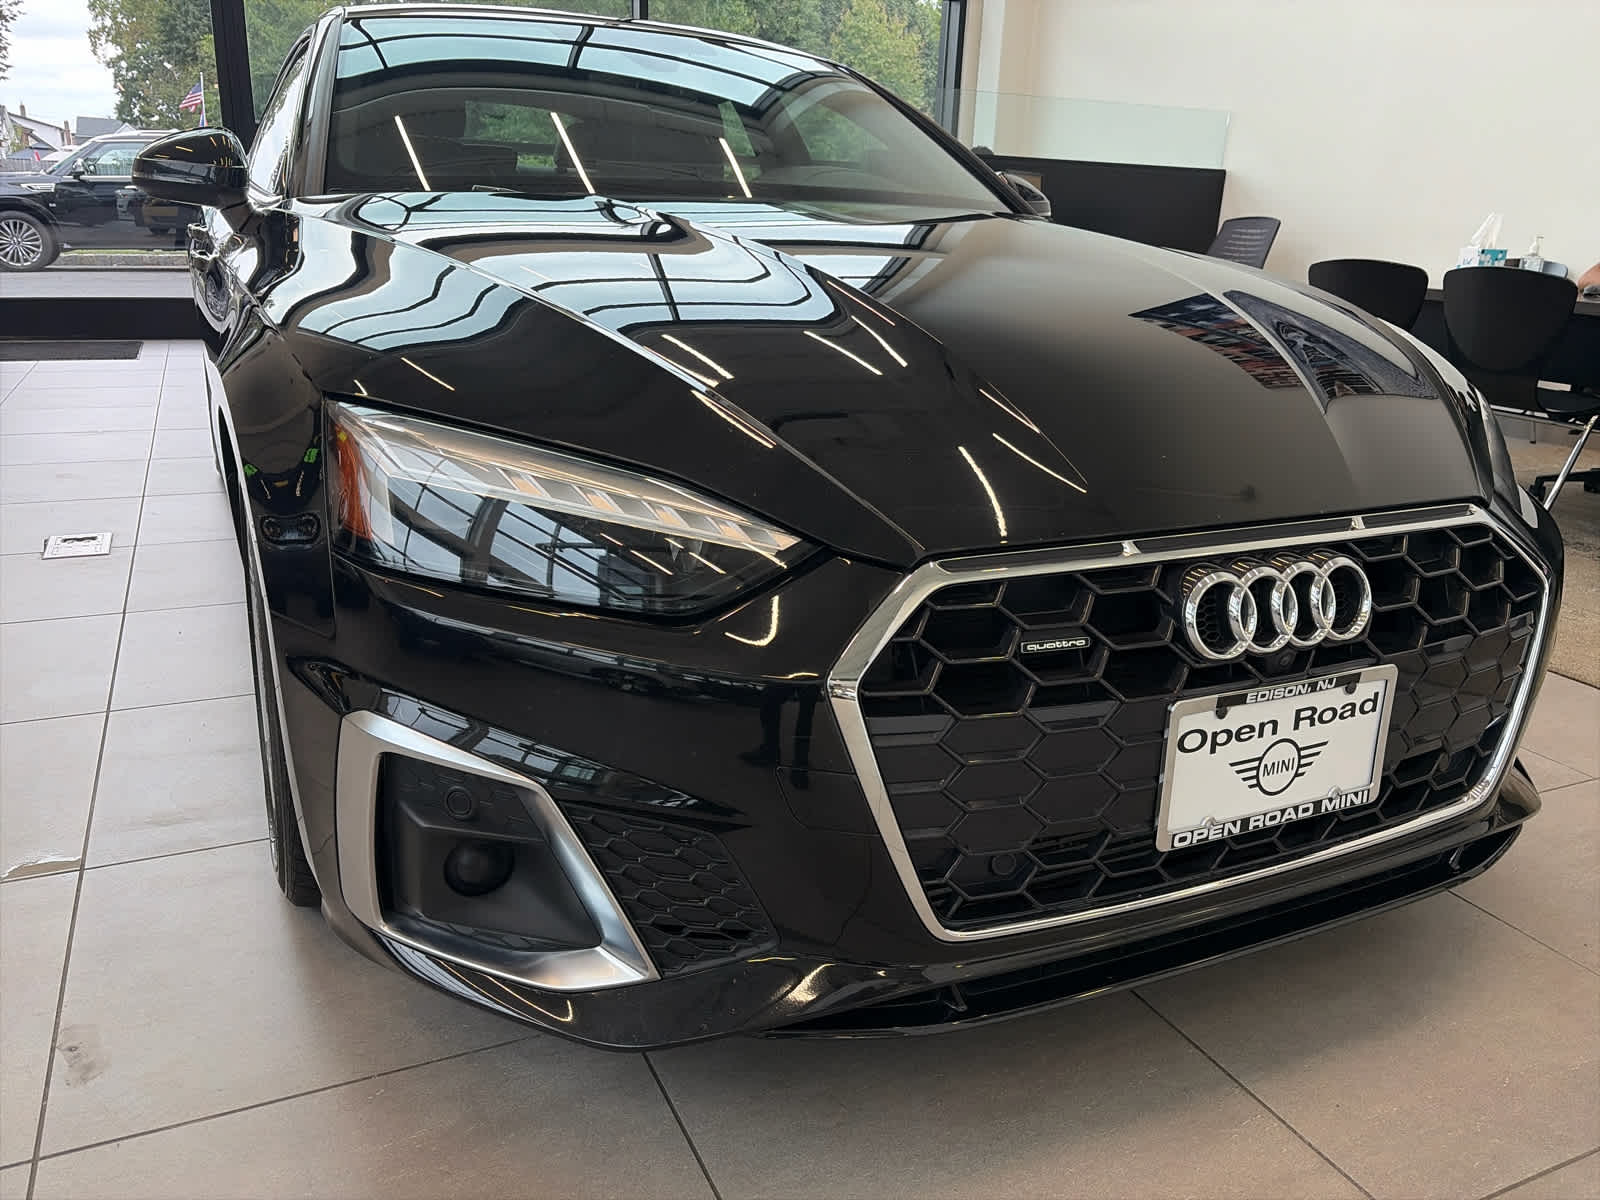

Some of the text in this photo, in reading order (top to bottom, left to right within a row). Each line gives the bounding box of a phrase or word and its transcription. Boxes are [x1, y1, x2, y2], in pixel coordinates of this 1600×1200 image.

[1026, 639, 1086, 652] quattro
[1246, 677, 1337, 704] EDISON, NJ
[1177, 691, 1380, 755] Open Road
[1262, 757, 1296, 778] MINI
[1173, 789, 1370, 849] OPEN ROAD MINI
